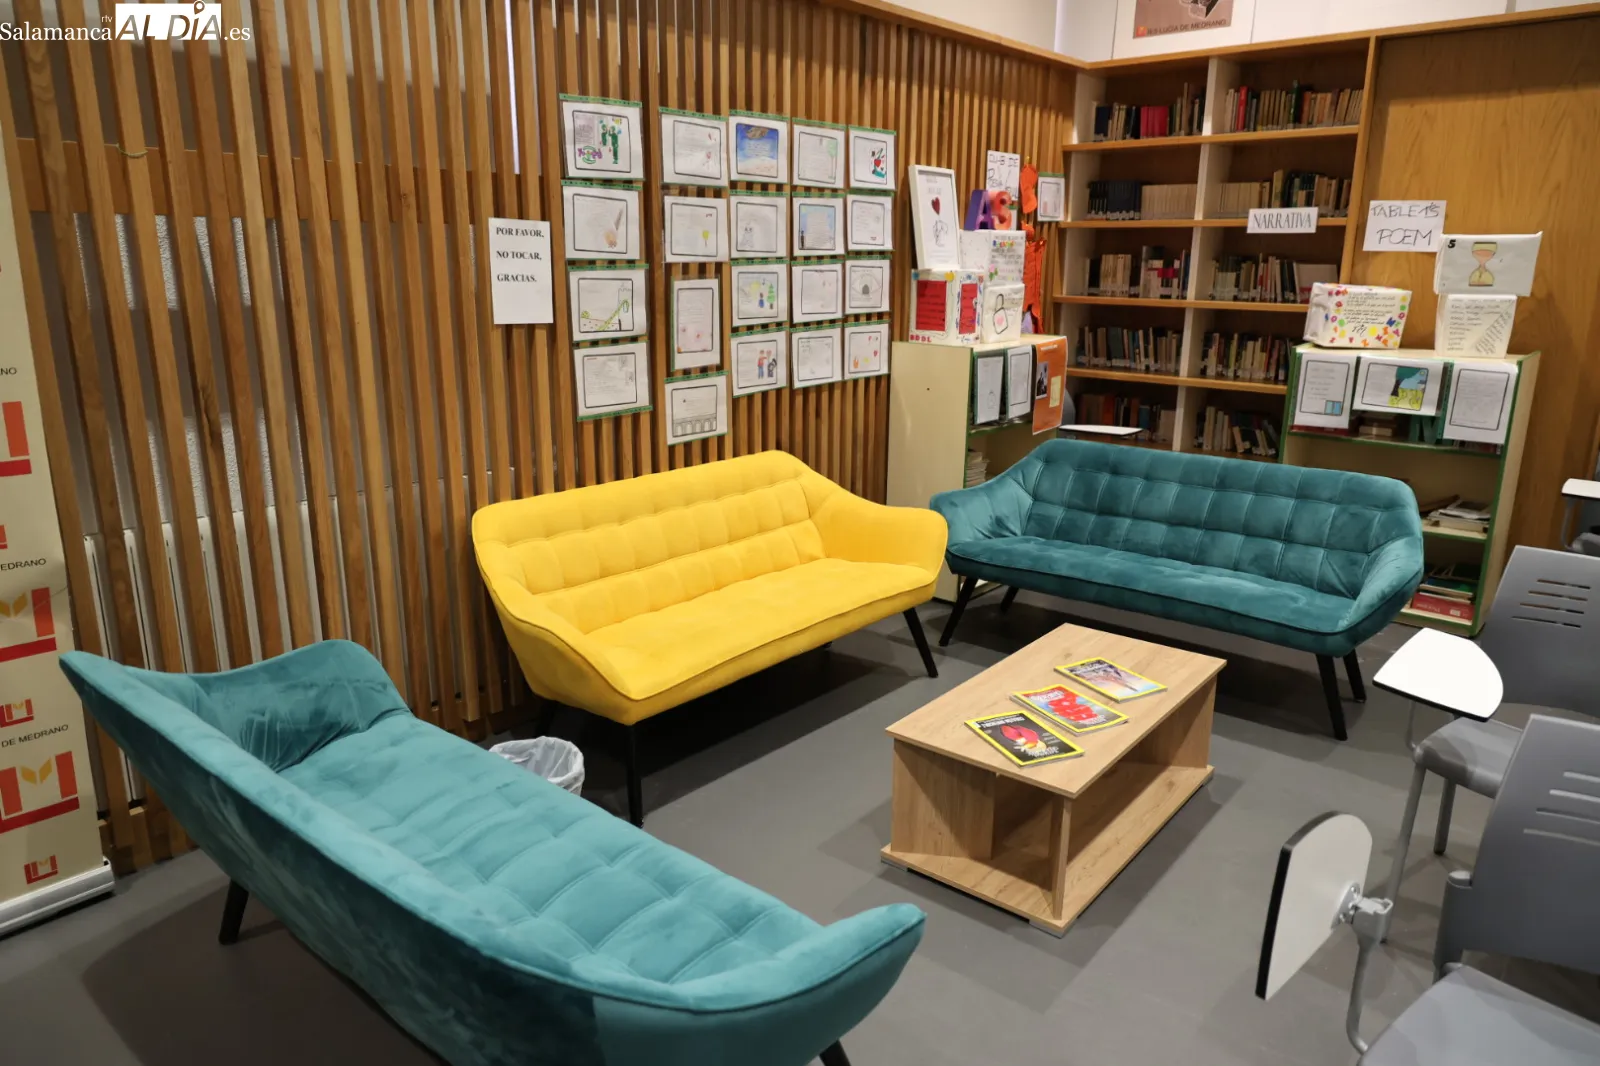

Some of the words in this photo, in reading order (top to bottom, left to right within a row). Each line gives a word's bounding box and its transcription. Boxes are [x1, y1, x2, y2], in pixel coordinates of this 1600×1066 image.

[1180, 23, 1190, 31] DE
[1190, 18, 1227, 30] MEDRANO
[1371, 204, 1420, 218] TABLE
[1253, 212, 1312, 230] NARRATIVA
[496, 227, 514, 236] POR
[515, 228, 545, 238] FAVOR,
[1377, 228, 1433, 246] POEM
[1447, 239, 1456, 249] 5
[496, 250, 509, 259] NO
[496, 273, 537, 283] GRACIAS.
[0, 367, 17, 376] NO
[1, 738, 16, 748] DE
[18, 724, 69, 743] MEDRANO
